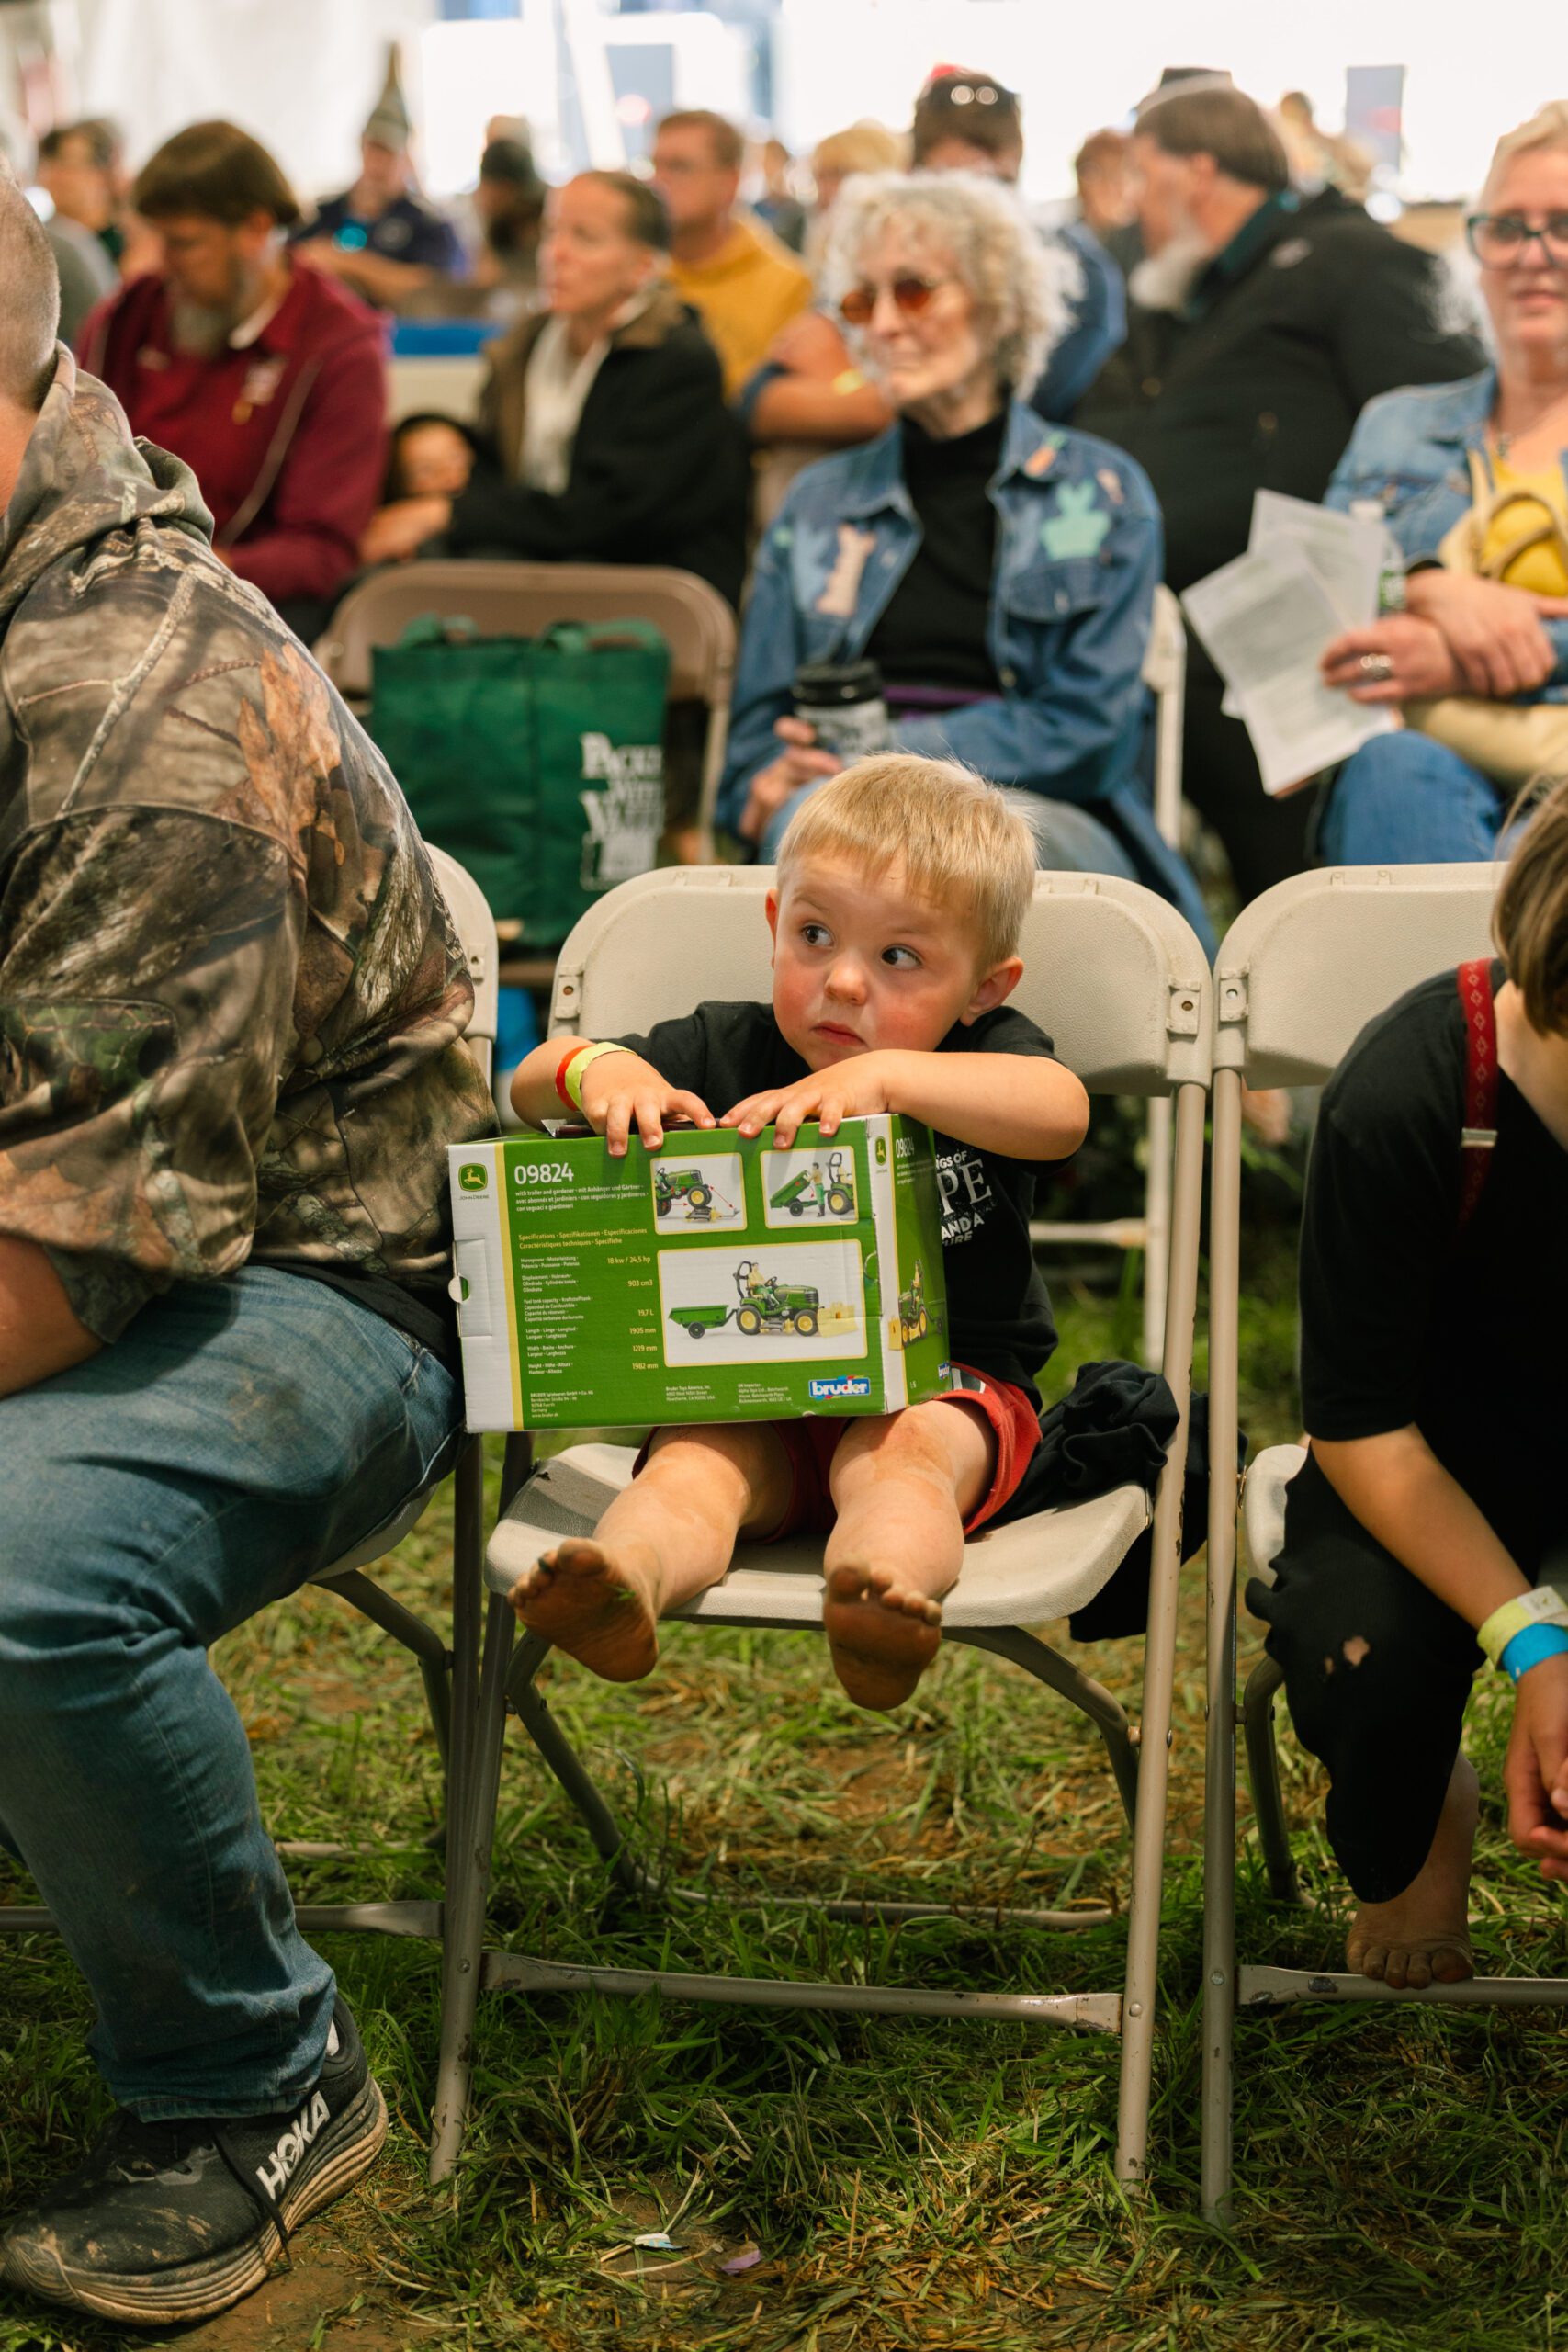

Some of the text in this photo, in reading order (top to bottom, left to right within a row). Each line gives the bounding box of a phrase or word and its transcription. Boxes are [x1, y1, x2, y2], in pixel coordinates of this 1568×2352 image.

[896, 1138, 914, 1158] 09824
[953, 1150, 967, 1164] OF
[514, 1162, 574, 1185] 09824
[554, 1195, 577, 1204] jardiniers
[941, 1212, 985, 1240] AND A
[518, 1228, 648, 1241] Specifications Spezifikationen Especificaciones
[942, 1231, 973, 1246] URE
[519, 1238, 622, 1250] Caractéristiques techniques Specifiche
[643, 1255, 651, 1263] hp
[812, 1380, 868, 1395] bruder
[256, 2090, 330, 2200] HOKA
